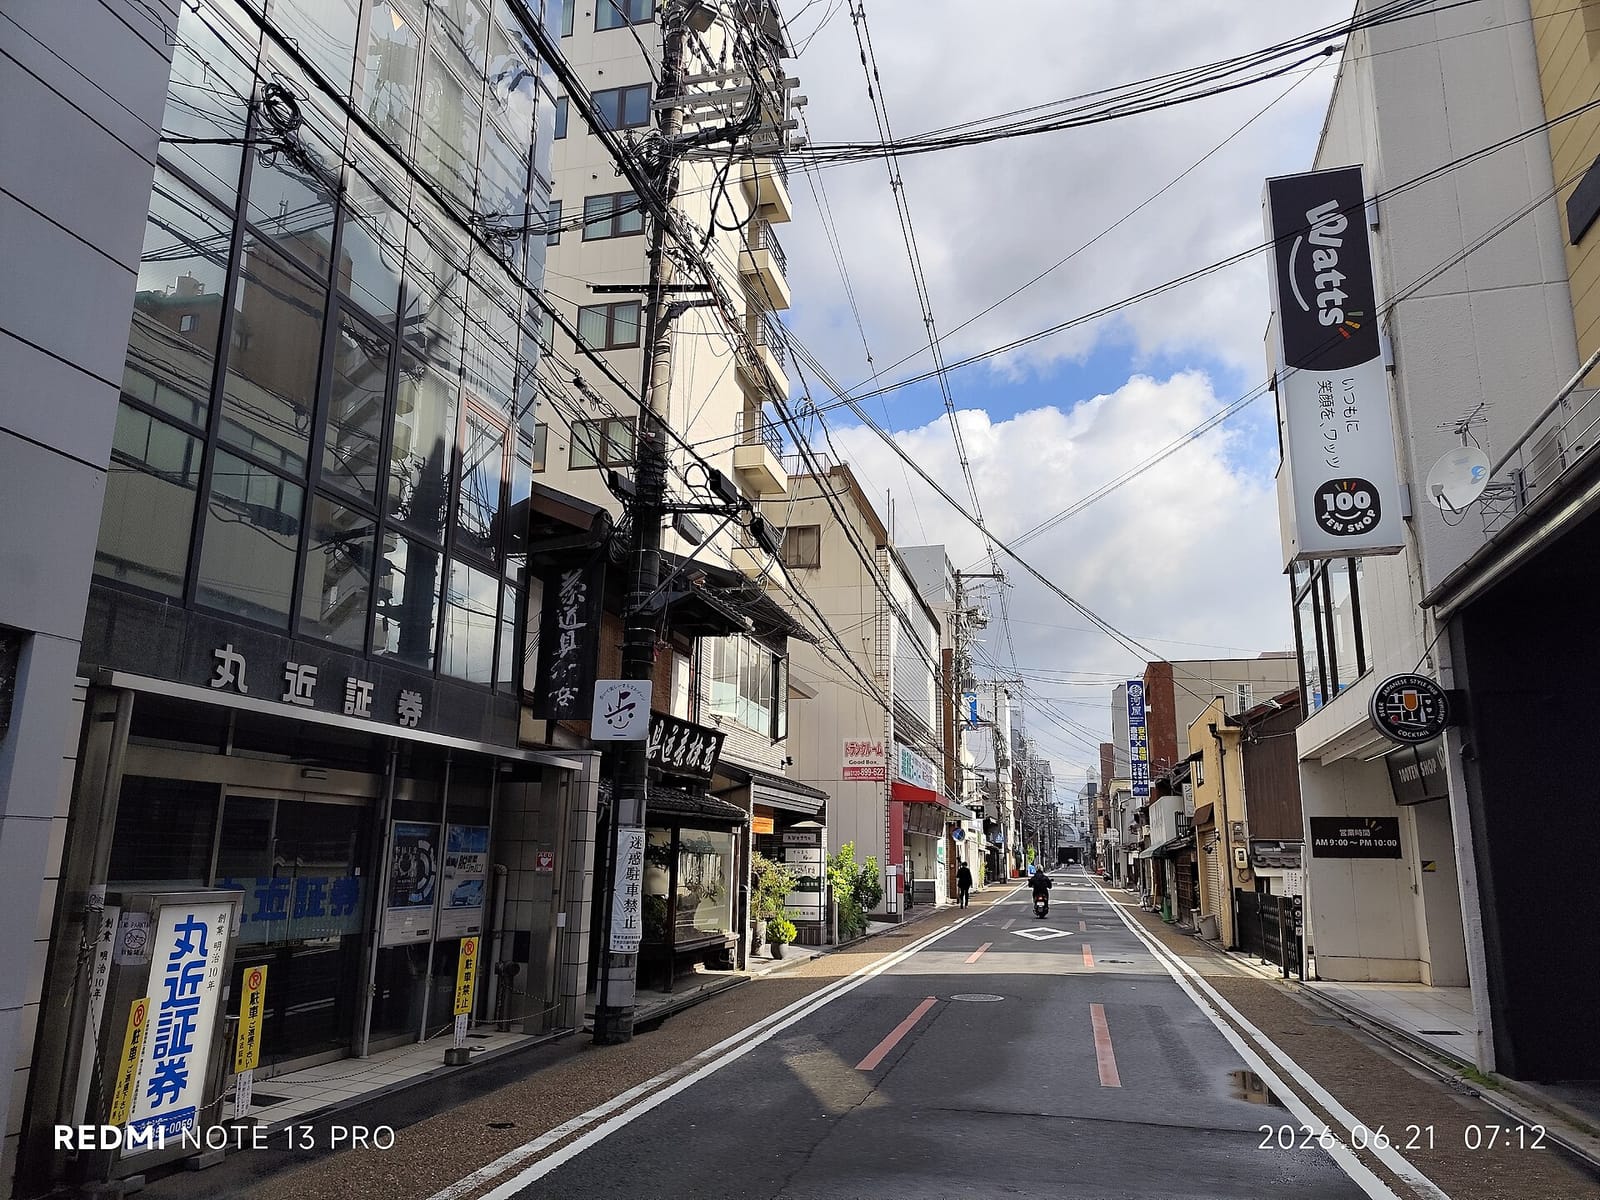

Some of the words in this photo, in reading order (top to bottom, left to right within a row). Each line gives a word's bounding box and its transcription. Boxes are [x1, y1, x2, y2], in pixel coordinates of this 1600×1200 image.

[1306, 200, 1348, 326] Watts
[1317, 380, 1340, 468] 笑顔を、ワッツ
[1342, 378, 1360, 433] いつもに
[1321, 512, 1344, 532] YEN
[1347, 509, 1376, 532] SHOP
[1323, 490, 1371, 512] 100
[211, 643, 423, 727] 丸近証券
[1378, 702, 1386, 717] BEER
[1382, 678, 1408, 697] JAPANESE
[1409, 678, 1427, 688] STYLE
[1427, 683, 1438, 696] PUB
[1397, 729, 1430, 738] COCKTAIL
[1374, 839, 1397, 847] 10:00
[622, 836, 642, 929] 迷惑駐車禁止
[214, 913, 227, 936] 創業
[92, 950, 109, 1001] 明治10年
[207, 941, 222, 991] 明治10年
[460, 958, 473, 1009] 駐車禁止
[146, 914, 208, 1109] 丸近証券
